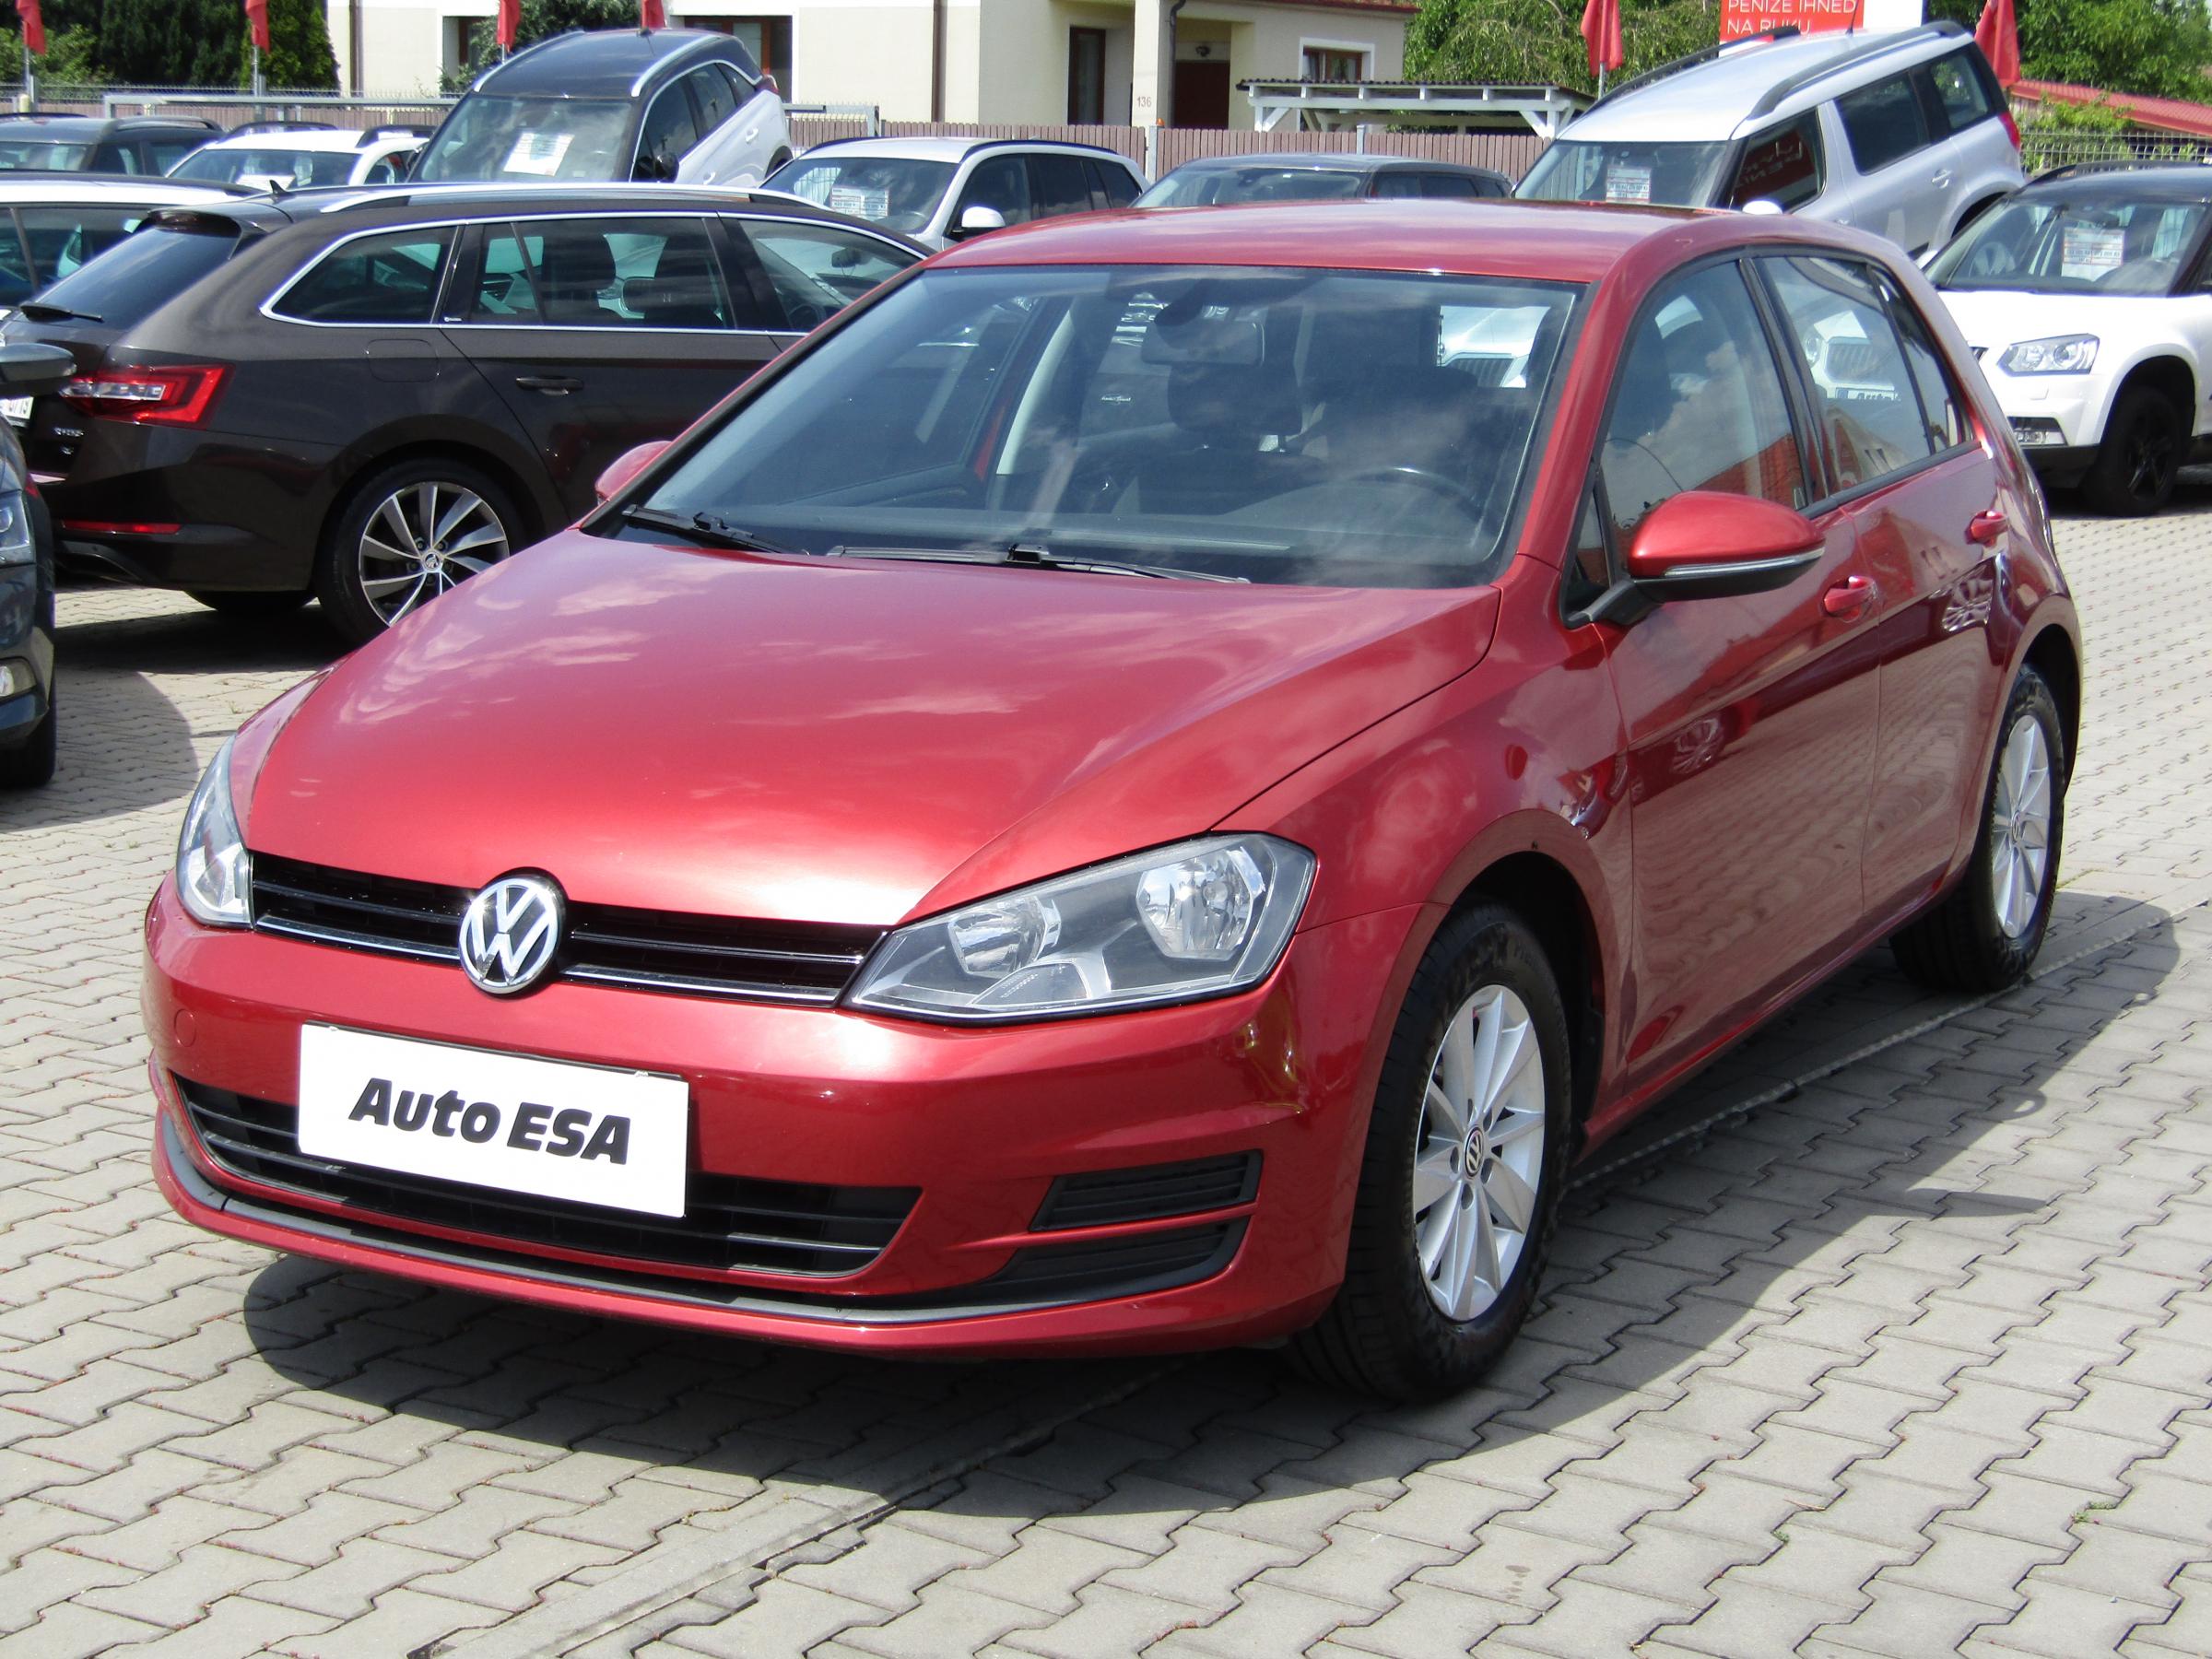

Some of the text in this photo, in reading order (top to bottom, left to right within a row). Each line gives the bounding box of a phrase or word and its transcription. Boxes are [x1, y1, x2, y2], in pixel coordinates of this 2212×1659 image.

[1799, 0, 1856, 13] IHNED
[1726, 19, 1754, 35] NA
[1136, 96, 1152, 108] 136
[348, 1077, 631, 1166] Auto ESA
